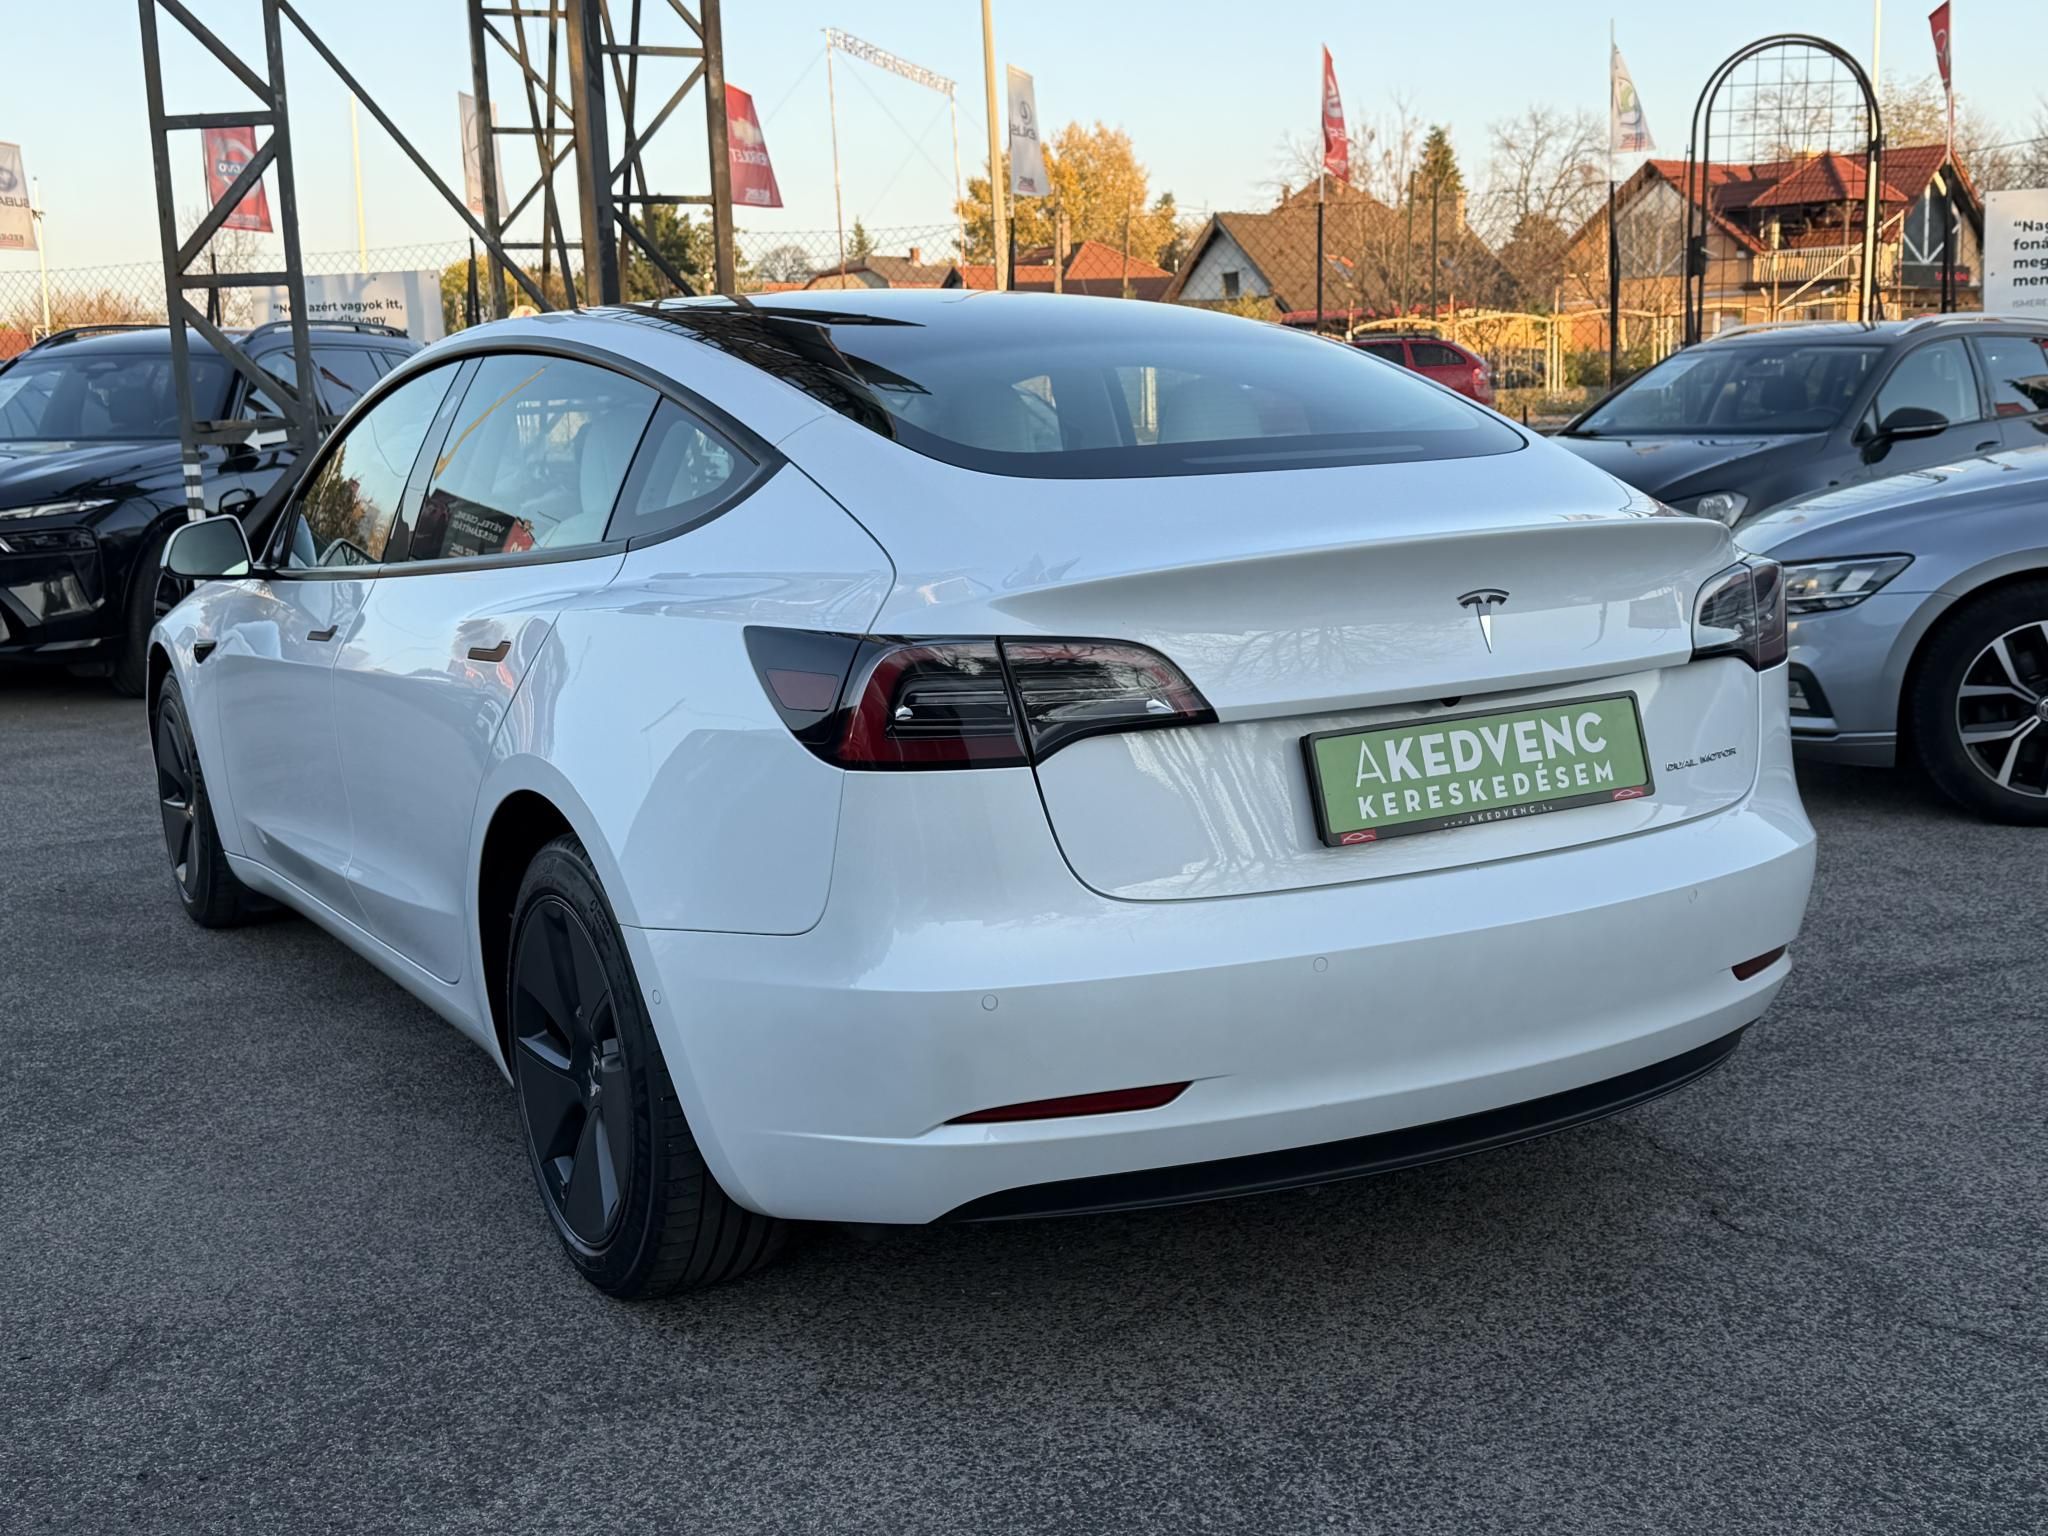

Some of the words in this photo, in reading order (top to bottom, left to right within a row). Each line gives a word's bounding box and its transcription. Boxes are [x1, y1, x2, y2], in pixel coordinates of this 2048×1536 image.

[2013, 258, 2048, 270] meg
[308, 302, 337, 312] azért
[341, 299, 383, 312] vagyok
[386, 298, 403, 310] itt,
[1355, 712, 1608, 788] AKEDVENC
[1666, 759, 1698, 772] DUAL
[1699, 747, 1737, 764] MOTOR
[1358, 759, 1614, 820] KERESKEDÉSEM
